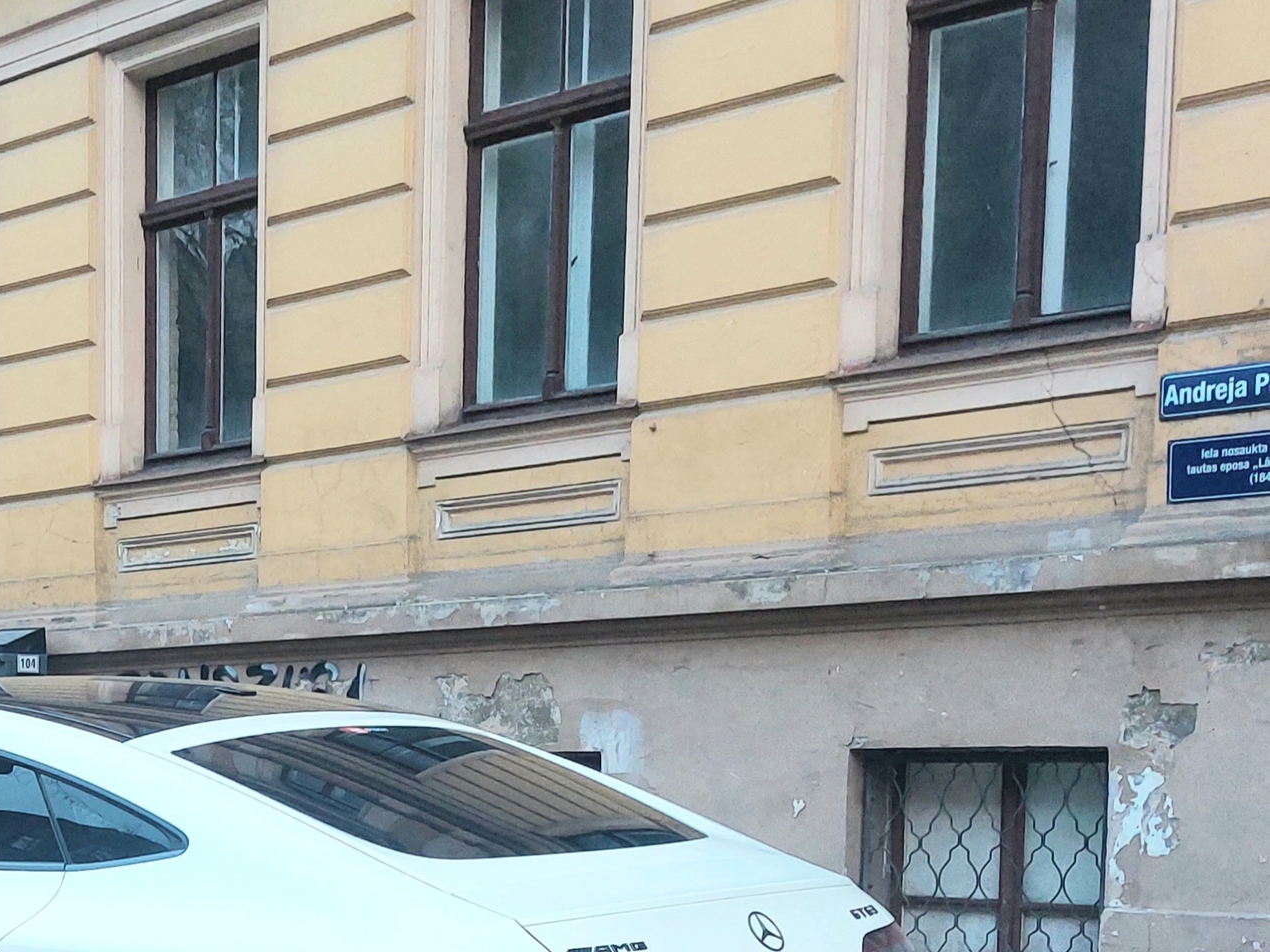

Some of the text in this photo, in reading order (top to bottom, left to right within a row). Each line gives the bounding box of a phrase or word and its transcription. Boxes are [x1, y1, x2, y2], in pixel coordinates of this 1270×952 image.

[1164, 372, 1270, 407] Andreja P
[1221, 443, 1268, 457] nosaukta
[1186, 463, 1218, 476] tautas
[1220, 460, 1250, 474] eposa
[20, 657, 36, 669] 104
